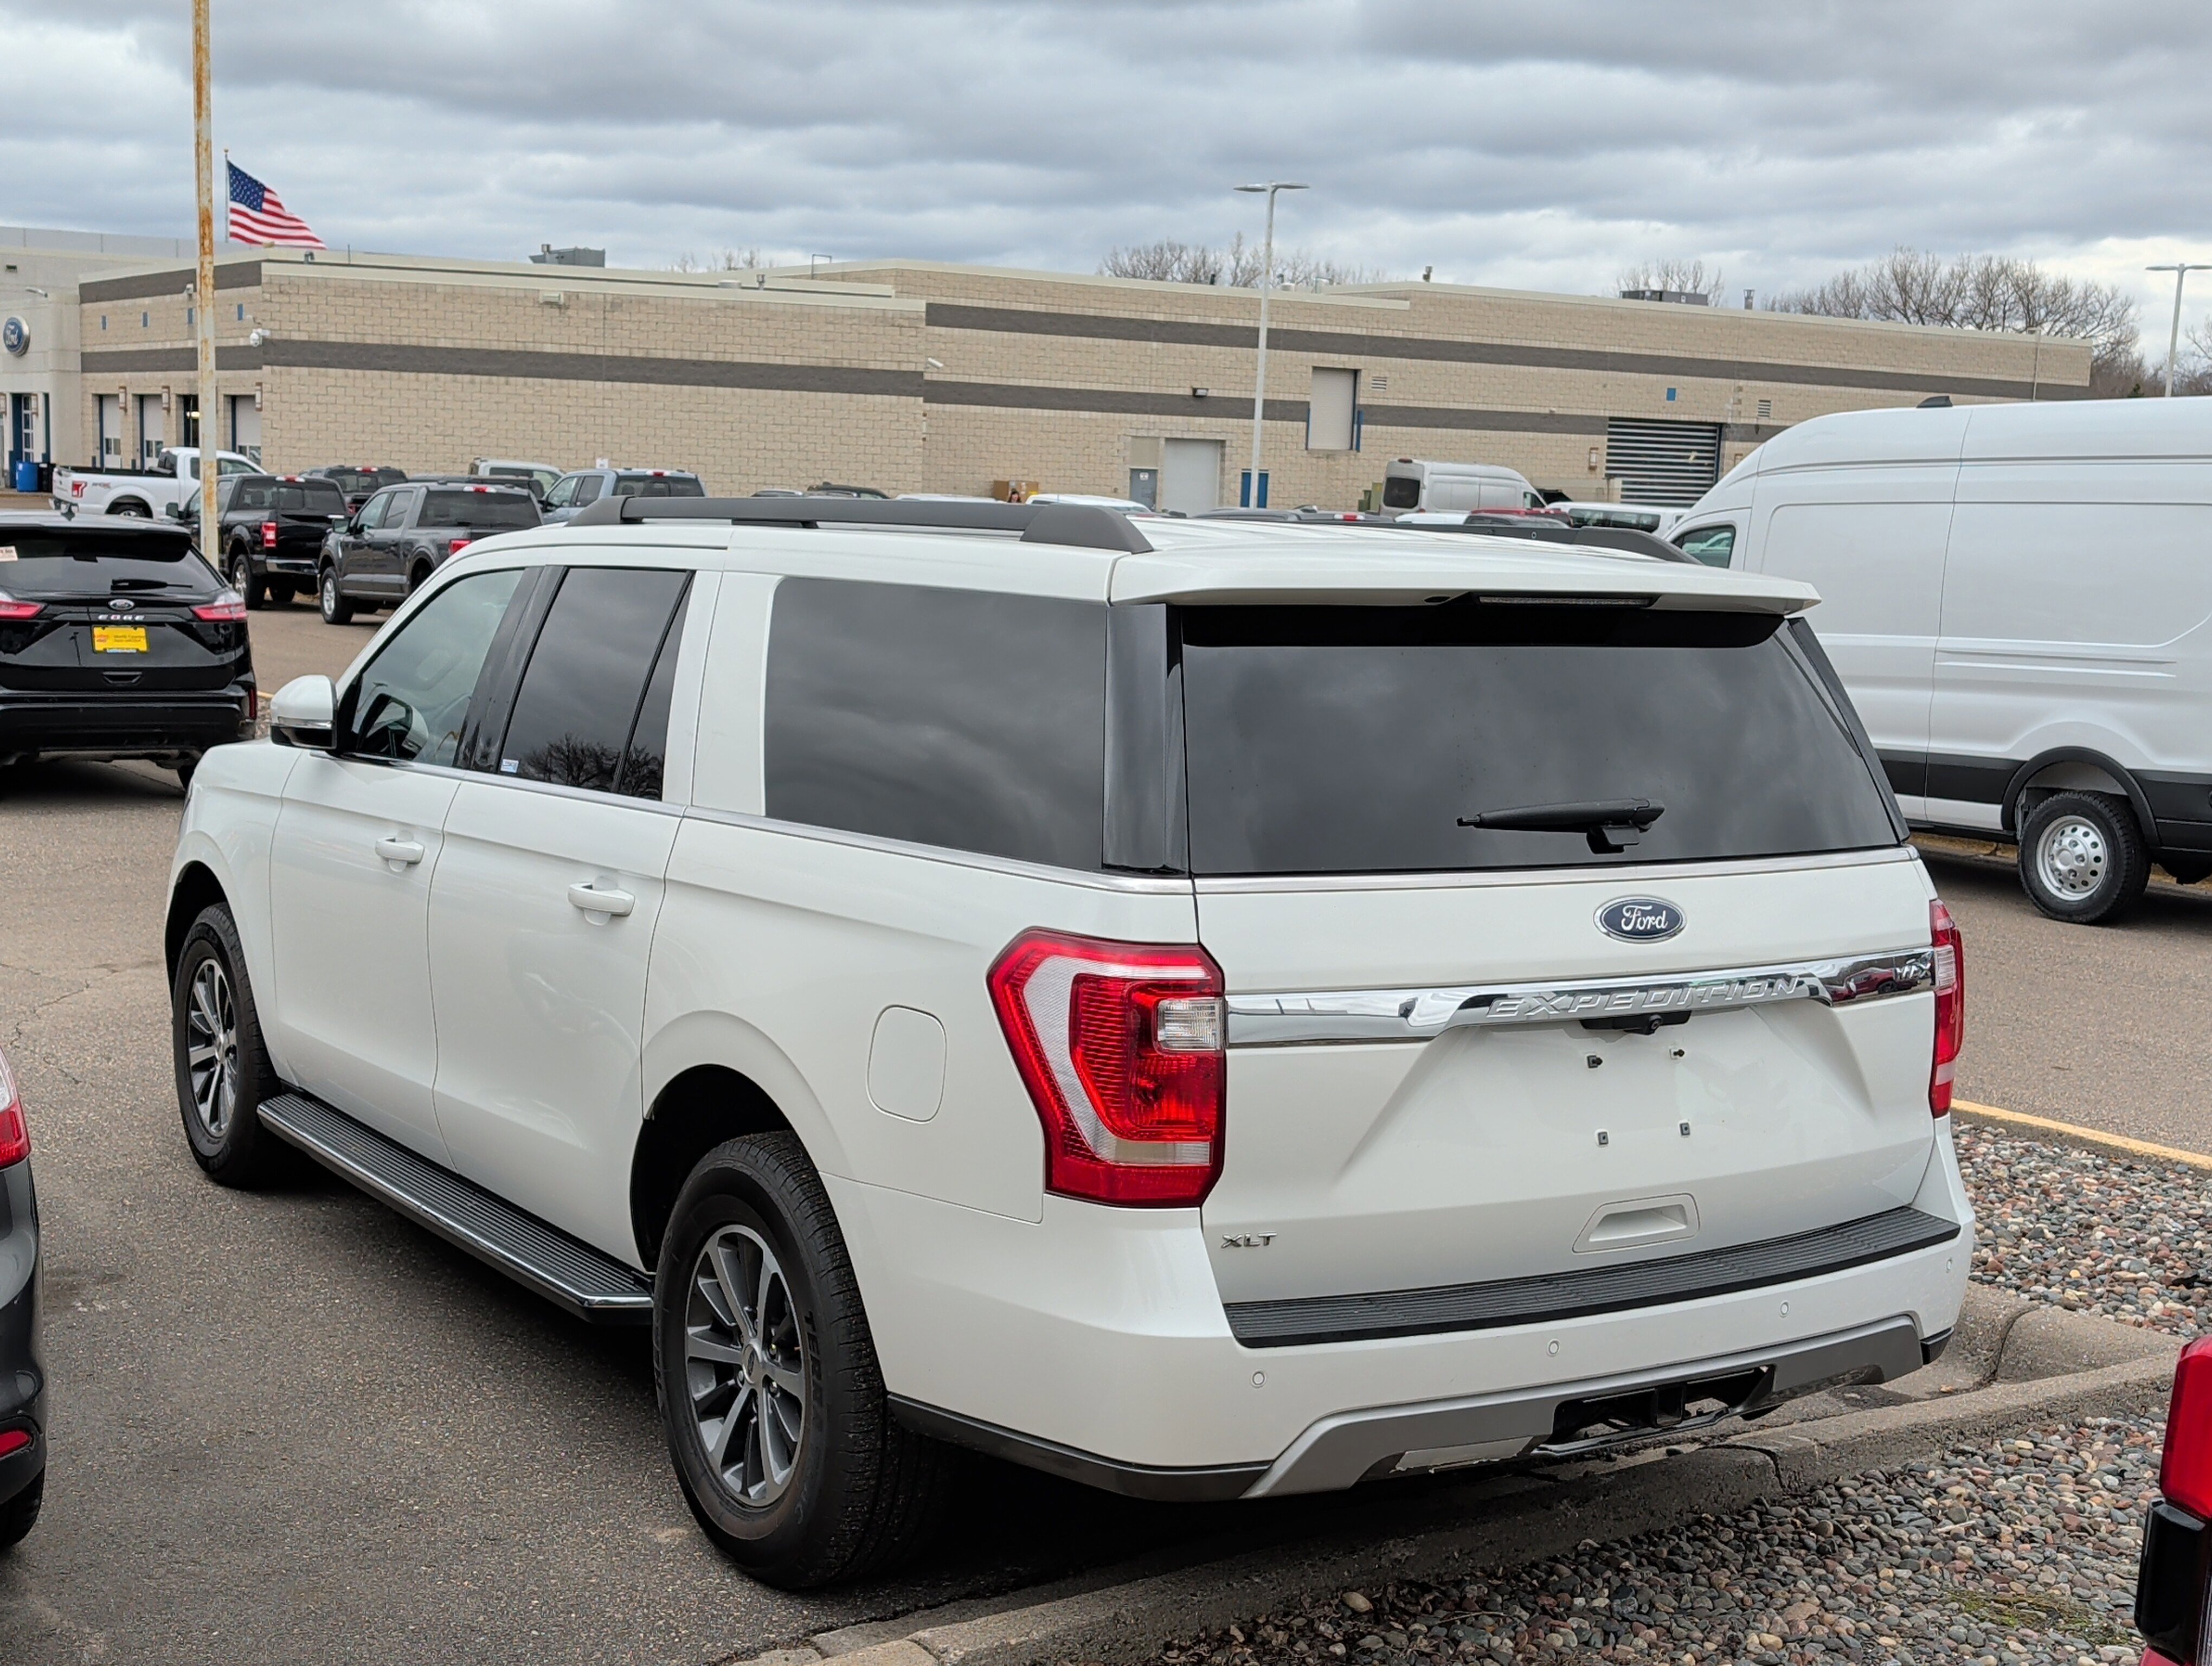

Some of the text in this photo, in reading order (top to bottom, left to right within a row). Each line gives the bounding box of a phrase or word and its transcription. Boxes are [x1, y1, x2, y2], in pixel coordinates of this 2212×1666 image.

[1621, 905, 1668, 931] Ford
[1895, 958, 1931, 981] MAX
[1486, 975, 1799, 1018] EXPEDITION
[1221, 1231, 1278, 1249] XLT
